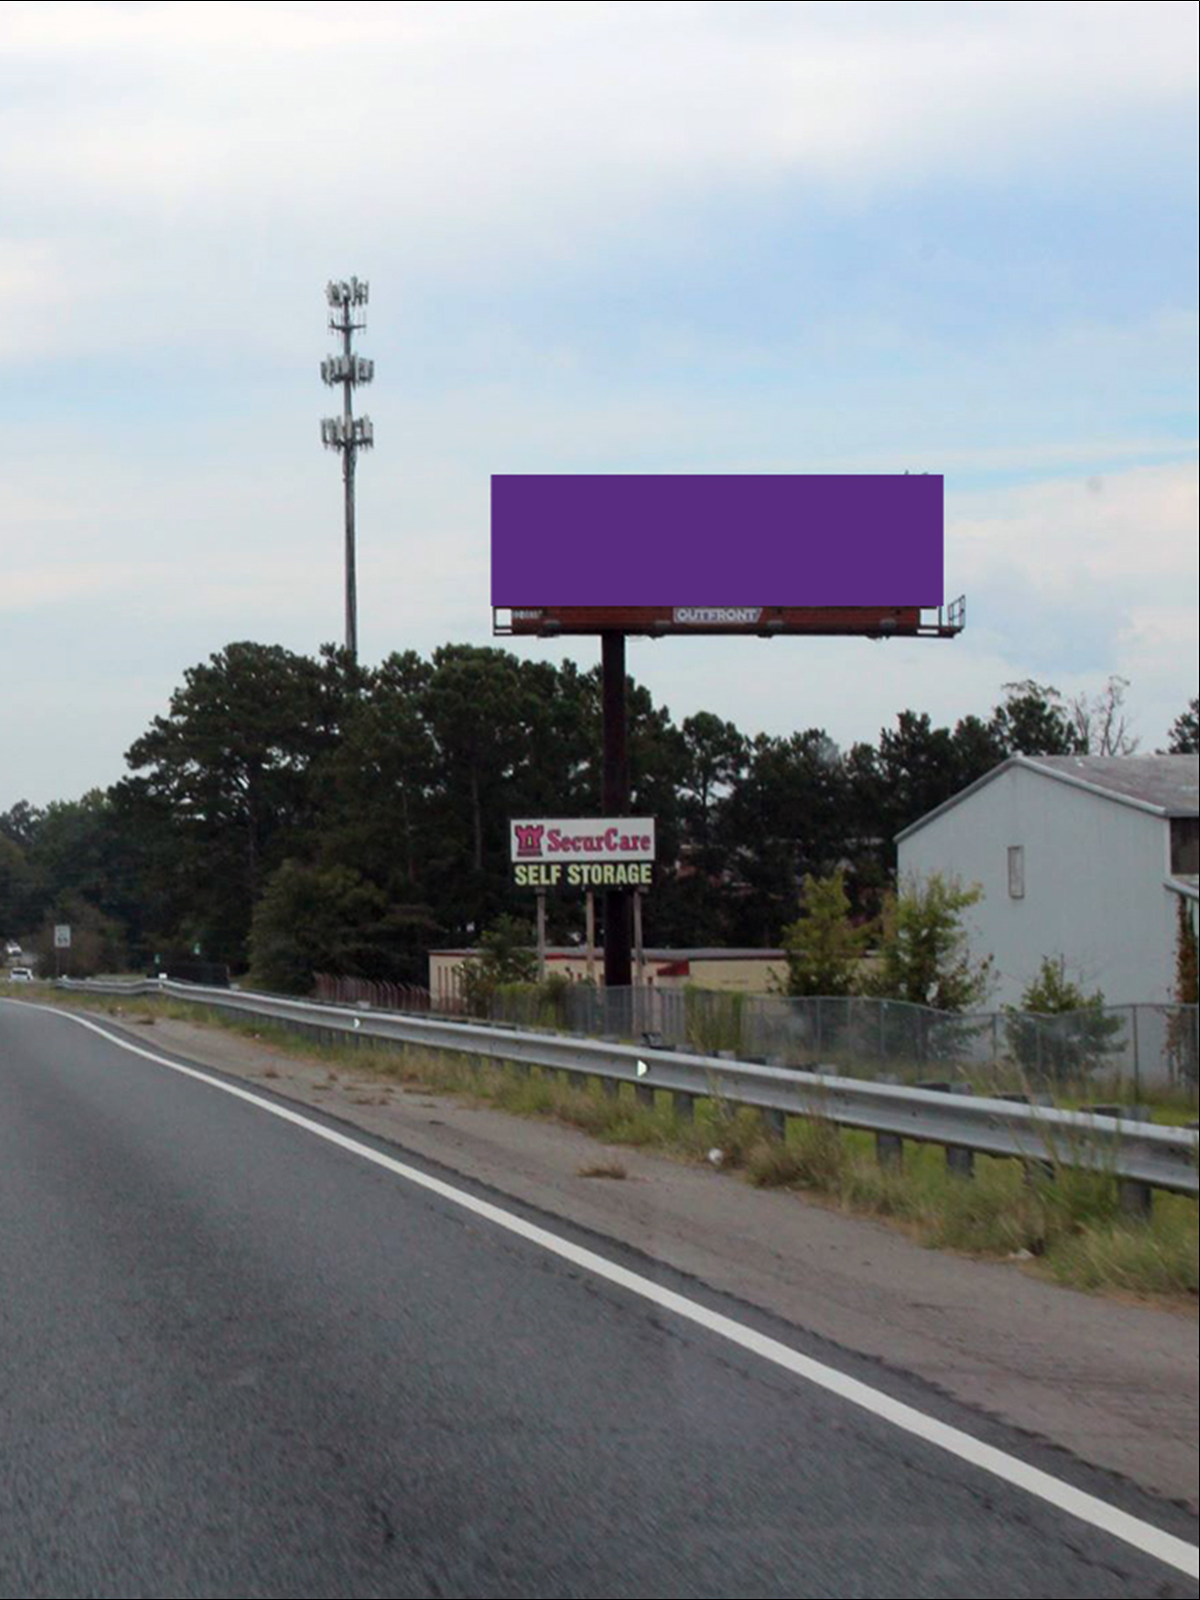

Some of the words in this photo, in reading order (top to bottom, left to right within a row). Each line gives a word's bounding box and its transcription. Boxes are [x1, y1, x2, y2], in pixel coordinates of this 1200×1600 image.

[677, 607, 758, 621] OUTFRONT
[547, 828, 651, 853] SecurCare
[514, 864, 561, 885] SELF
[567, 863, 652, 885] STORAGE
